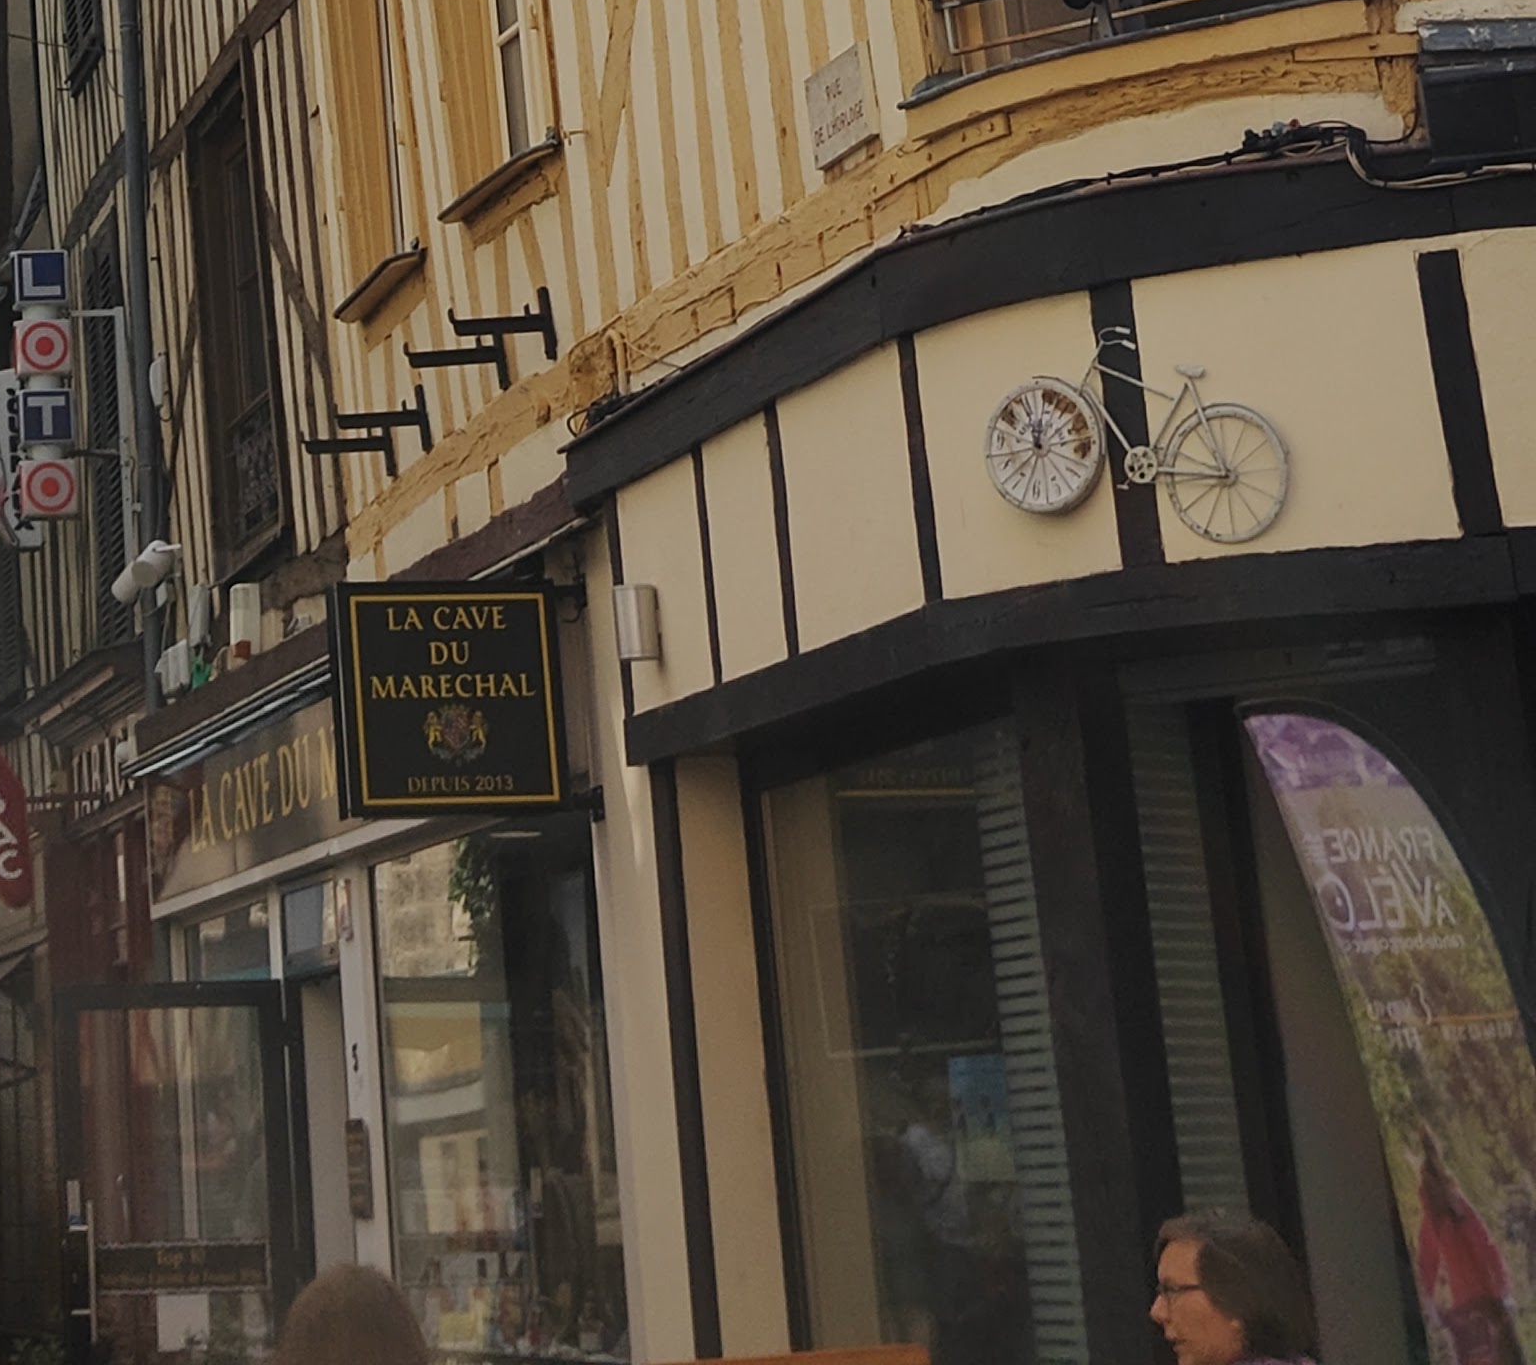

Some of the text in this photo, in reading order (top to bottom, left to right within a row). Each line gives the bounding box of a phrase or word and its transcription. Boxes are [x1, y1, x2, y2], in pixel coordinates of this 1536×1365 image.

[386, 606, 508, 631] LA CAVE
[429, 641, 470, 665] DU
[370, 673, 536, 699] MARECHAL
[188, 782, 216, 853] LA
[219, 752, 273, 841] CAVE
[276, 733, 311, 817] DU
[408, 774, 514, 792] DEPUIS 2013
